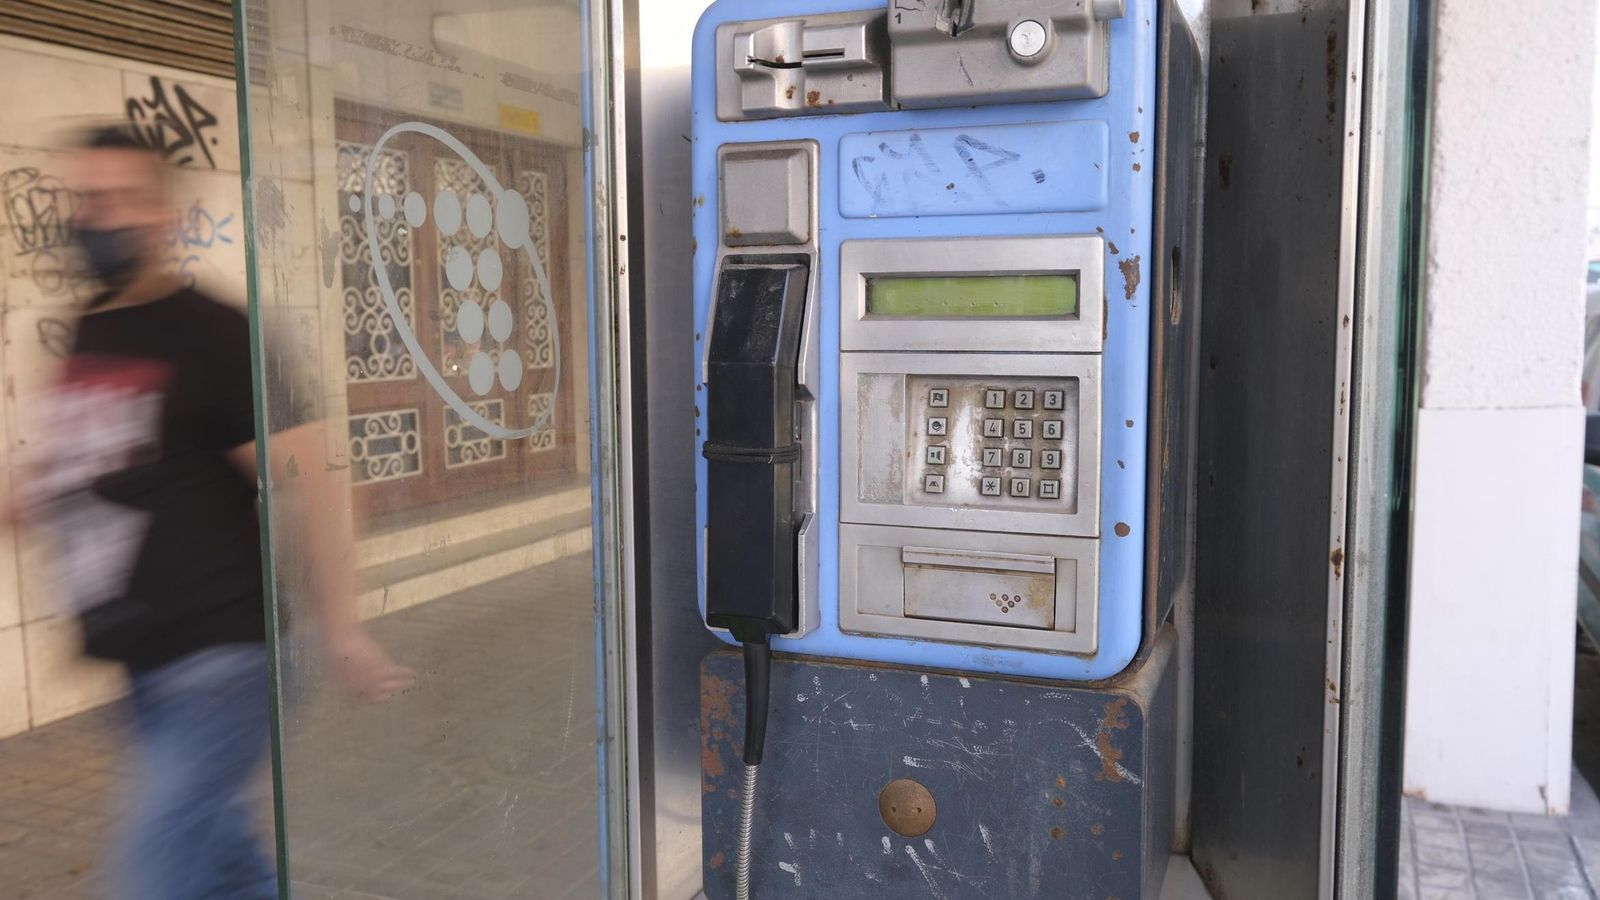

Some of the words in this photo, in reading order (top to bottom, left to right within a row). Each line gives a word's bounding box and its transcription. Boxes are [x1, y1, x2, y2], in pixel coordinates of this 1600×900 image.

[895, 12, 902, 24] 1
[992, 393, 998, 405] 1
[1020, 393, 1027, 405] 2
[1049, 394, 1057, 406] 3
[989, 421, 996, 434] 4
[1018, 423, 1026, 435] 5
[1047, 423, 1056, 435] 6
[988, 452, 995, 464] 7
[1017, 452, 1025, 465] 8
[1046, 453, 1054, 465] 9
[1016, 481, 1024, 493] 0
